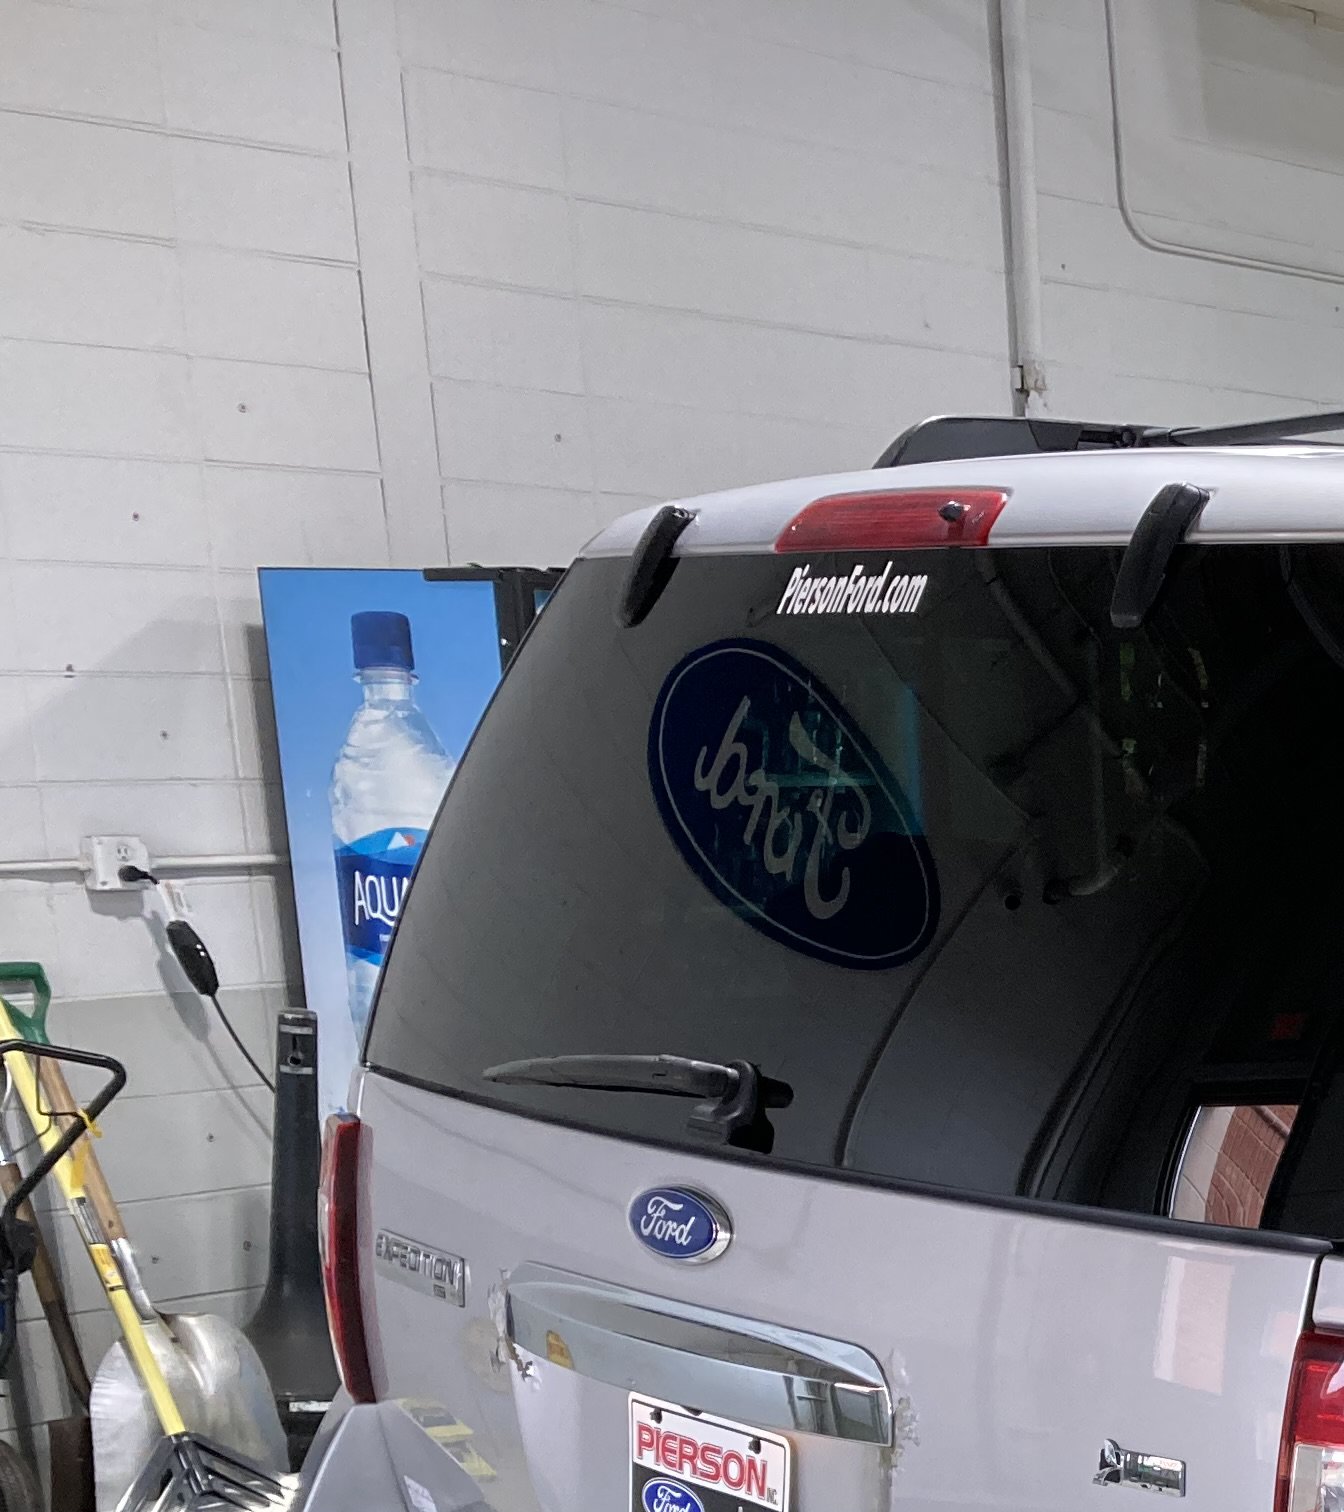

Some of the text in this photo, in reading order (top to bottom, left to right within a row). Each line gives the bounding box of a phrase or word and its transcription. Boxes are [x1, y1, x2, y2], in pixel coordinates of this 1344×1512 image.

[776, 560, 929, 615] PiersonFord.com
[640, 1195, 696, 1246] Ford
[376, 1231, 460, 1291] EXPEDITION
[636, 1421, 768, 1500] PIERSON
